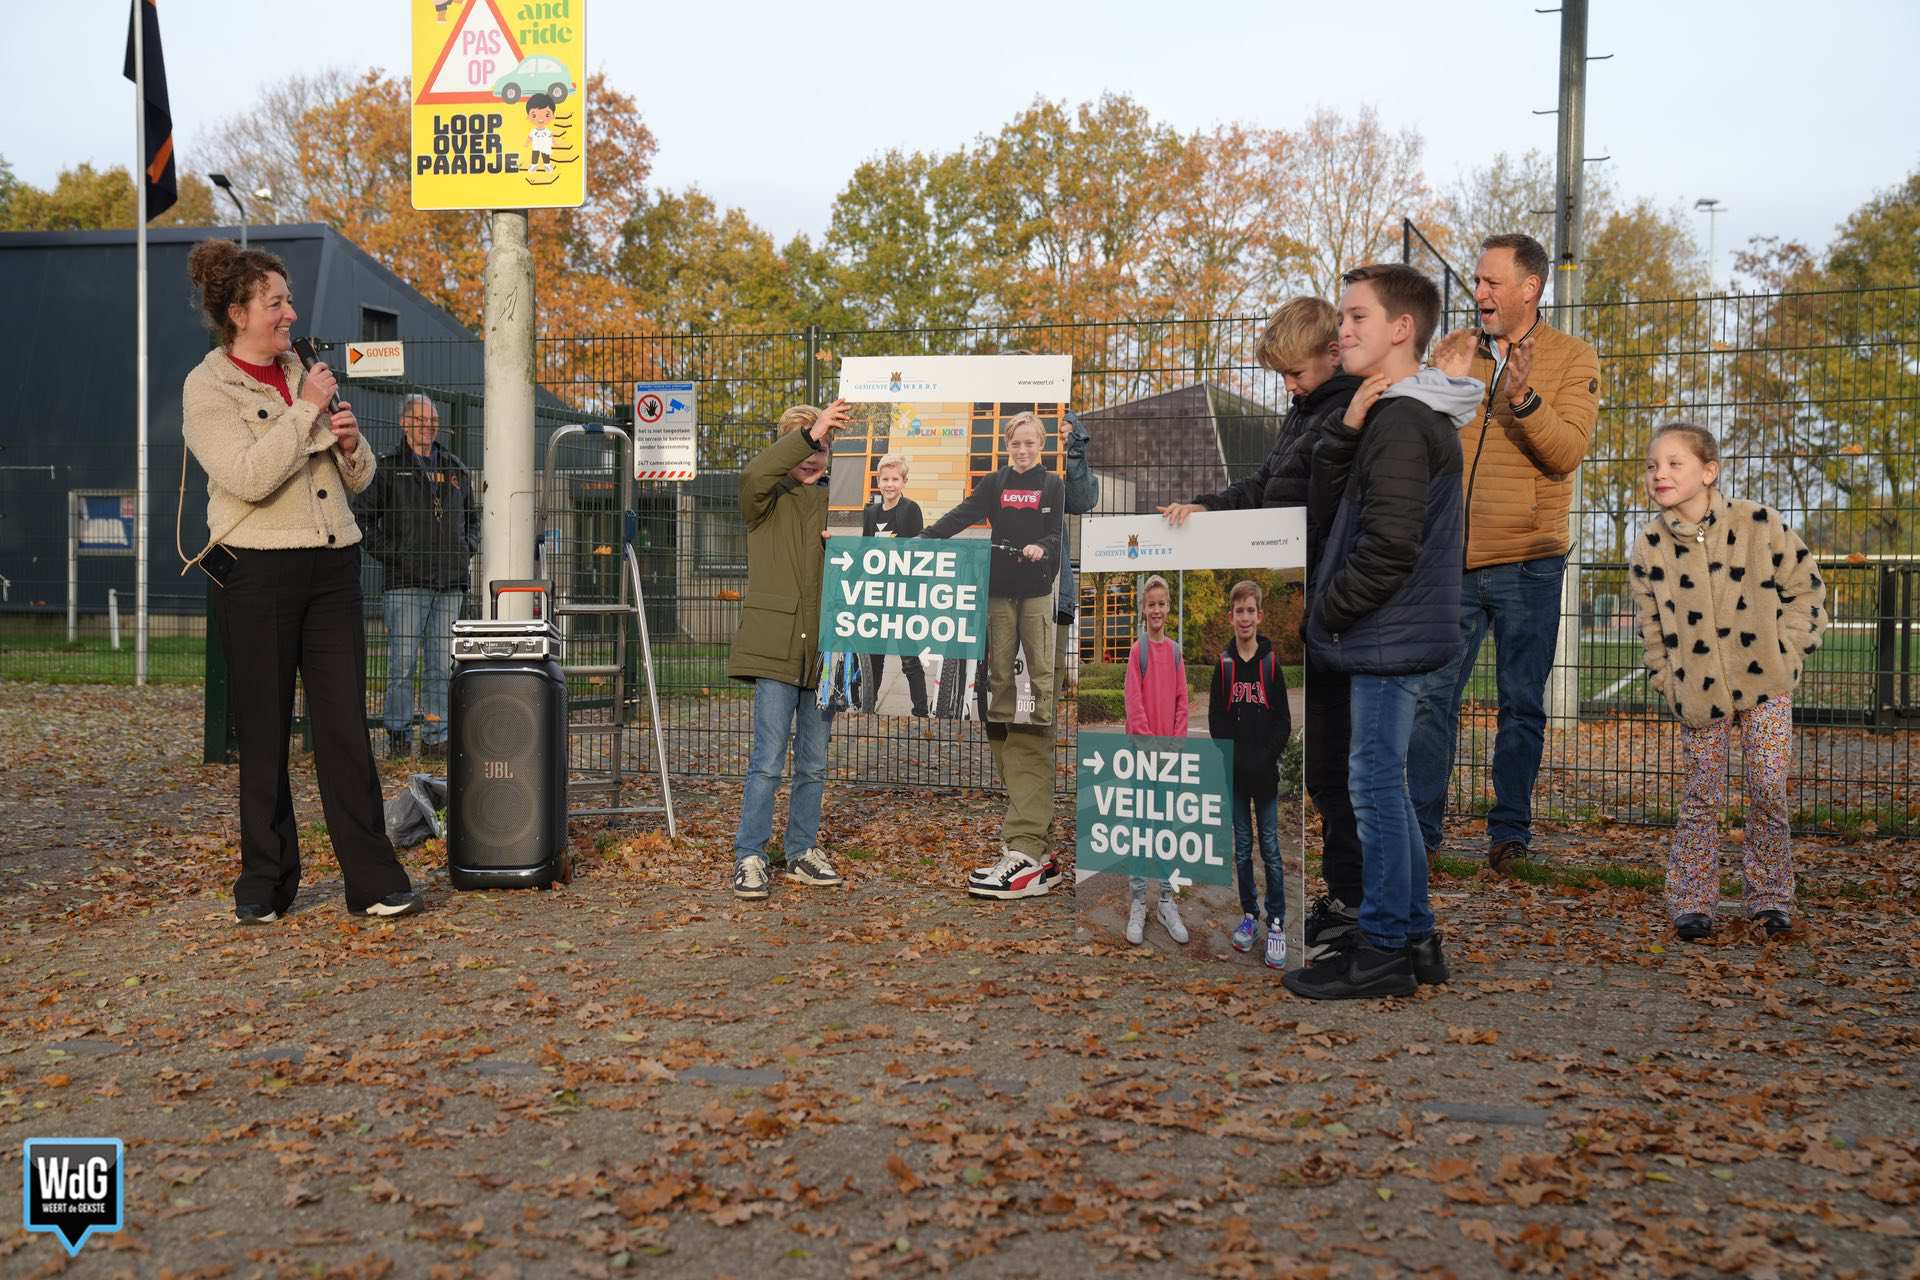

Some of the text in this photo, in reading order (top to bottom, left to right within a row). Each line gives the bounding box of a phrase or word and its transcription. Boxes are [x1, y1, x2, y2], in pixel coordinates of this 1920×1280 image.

[517, 0, 569, 20] and
[462, 30, 501, 55] PAS
[519, 22, 573, 45] ride
[468, 59, 496, 85] OP
[433, 114, 503, 135] LOOP
[433, 134, 503, 155] OVER
[416, 153, 520, 175] PAADJE
[366, 346, 400, 358] GOVERS
[1140, 547, 1173, 555] WEERT
[862, 549, 957, 578] ONZE
[841, 580, 977, 611] VEILIGE
[835, 611, 977, 643] SCHOOL
[1017, 700, 1035, 713] DUO
[484, 761, 514, 779] JBL
[1112, 749, 1200, 785] ONZE
[1093, 785, 1222, 826] VEILIGE
[1090, 822, 1224, 866] SCHOOL
[1267, 938, 1286, 954] DUO
